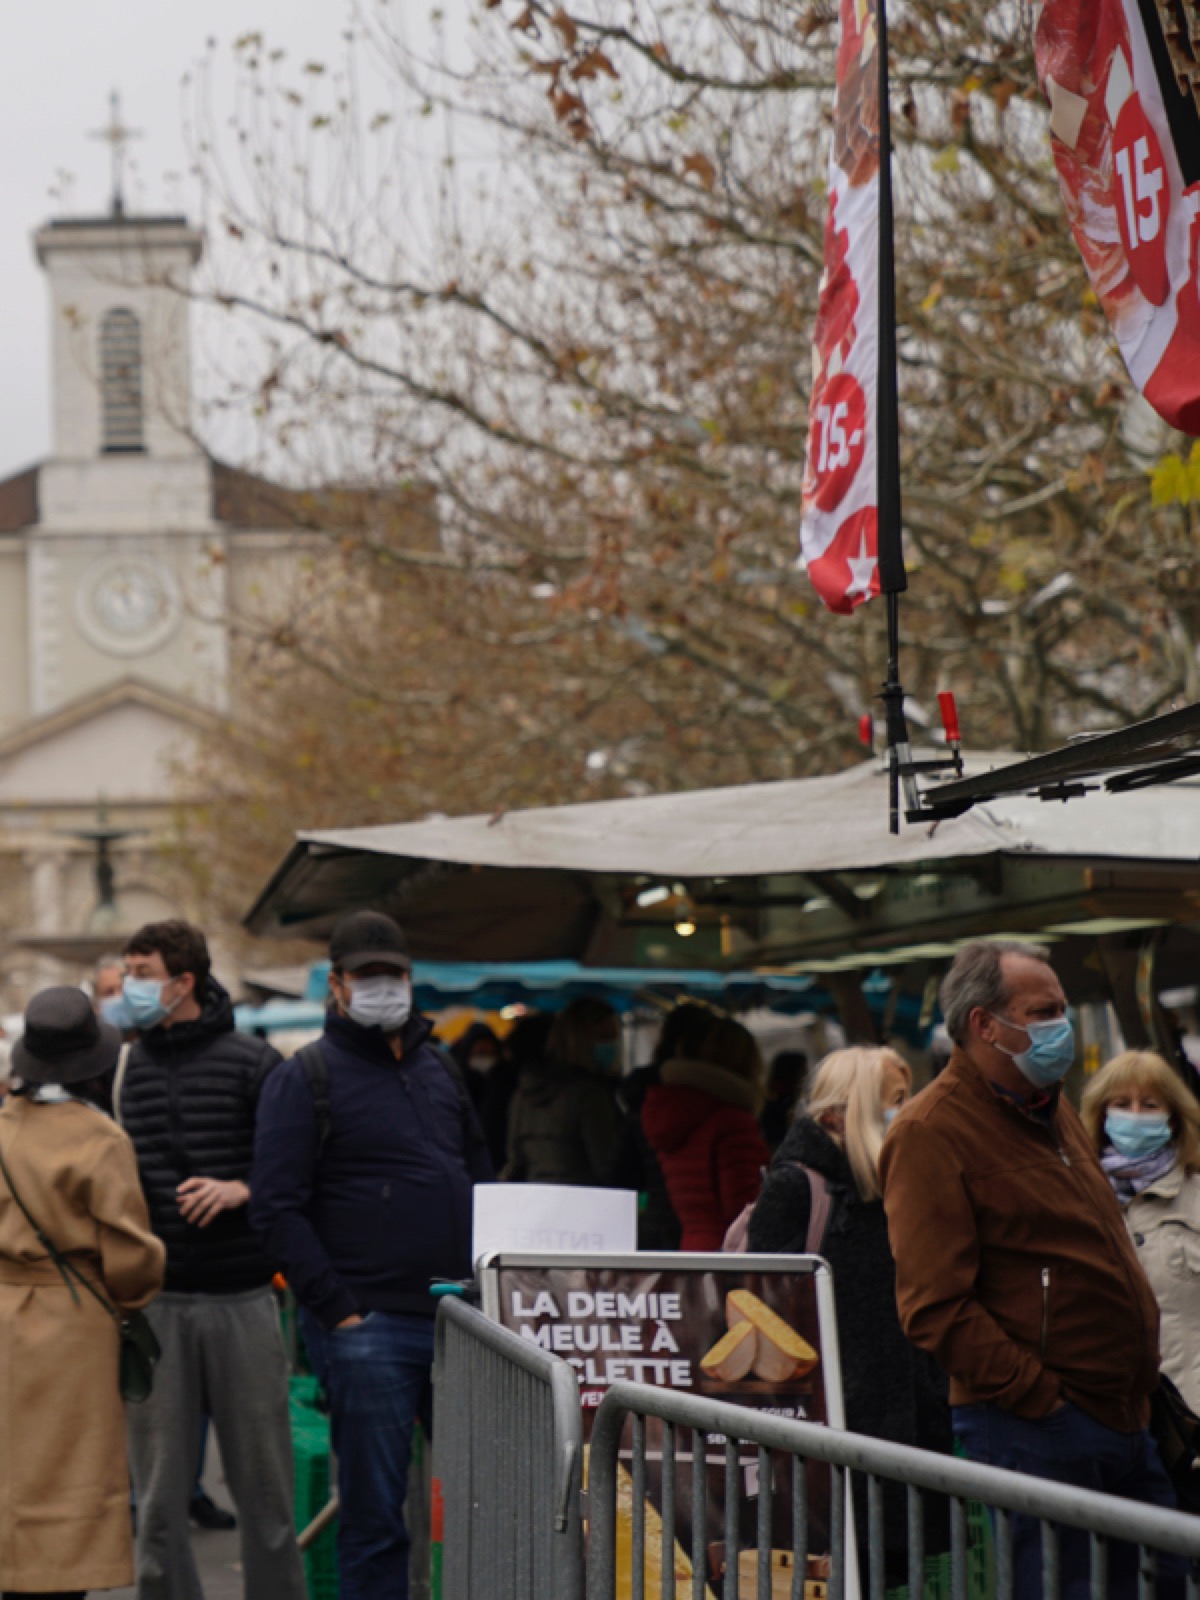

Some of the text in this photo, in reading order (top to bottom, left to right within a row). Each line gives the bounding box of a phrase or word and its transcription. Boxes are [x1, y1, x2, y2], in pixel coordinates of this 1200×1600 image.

[512, 1291, 682, 1319] LA DEMIE
[519, 1319, 680, 1353] MEULE À
[566, 1357, 693, 1386] CLETTE
